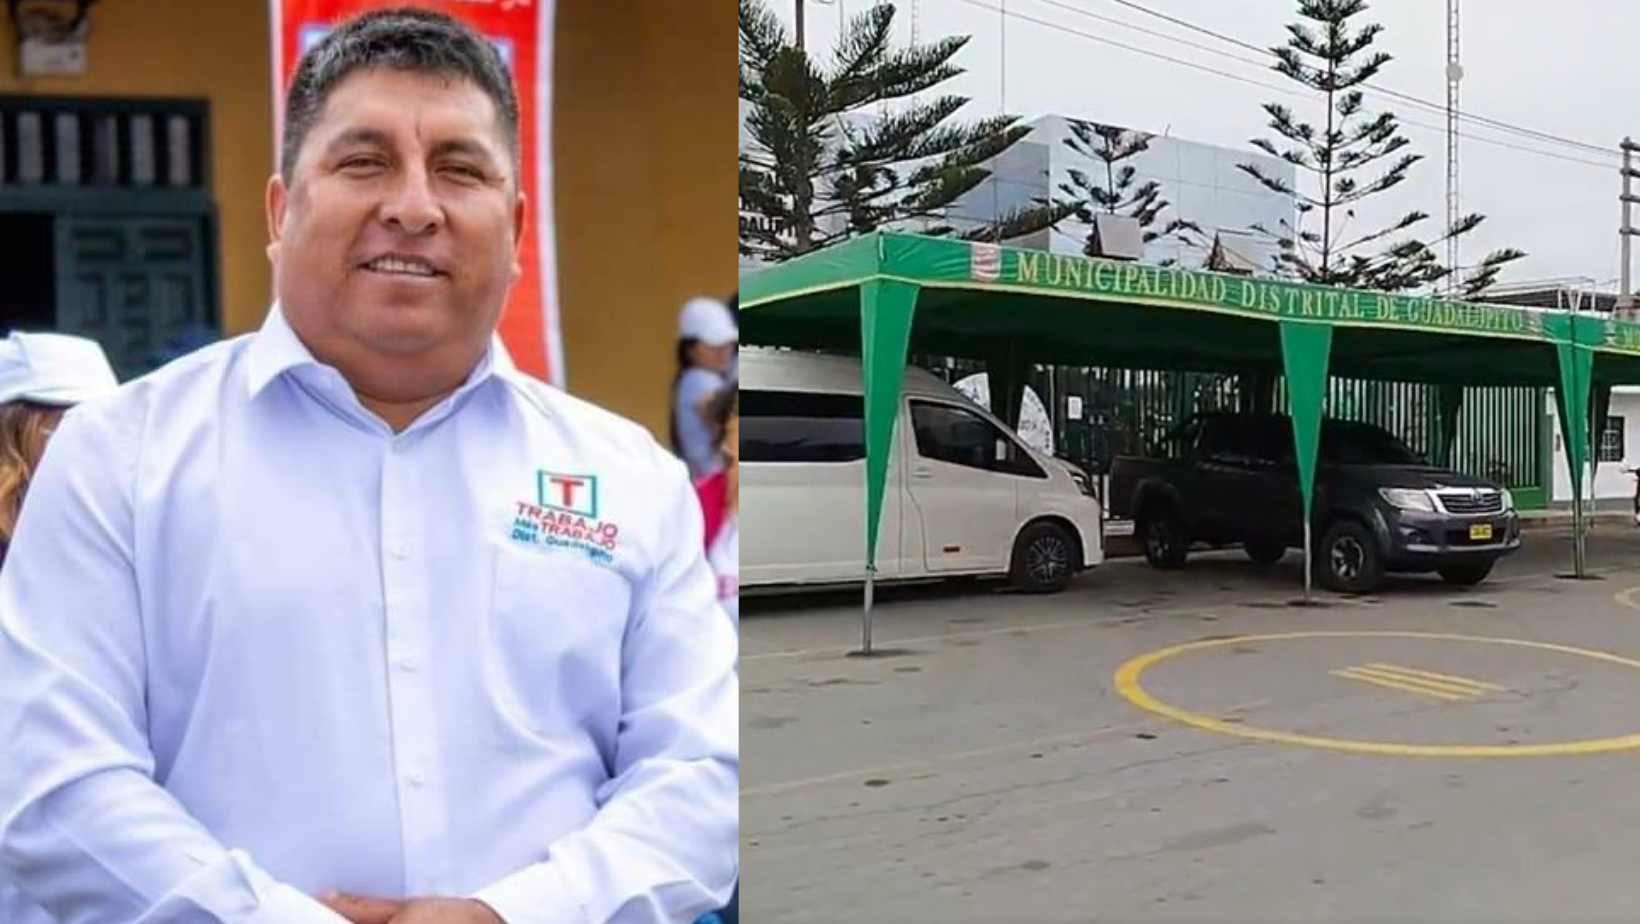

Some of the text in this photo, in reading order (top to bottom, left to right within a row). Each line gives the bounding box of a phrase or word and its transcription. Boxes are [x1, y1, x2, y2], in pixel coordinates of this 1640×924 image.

[1016, 251, 1524, 332] MUNICIPALIDAD DISTRITAL DE GUADALUPITO
[549, 476, 585, 507] T
[516, 501, 619, 539] TRABAJO
[541, 521, 616, 551] TRABAJO
